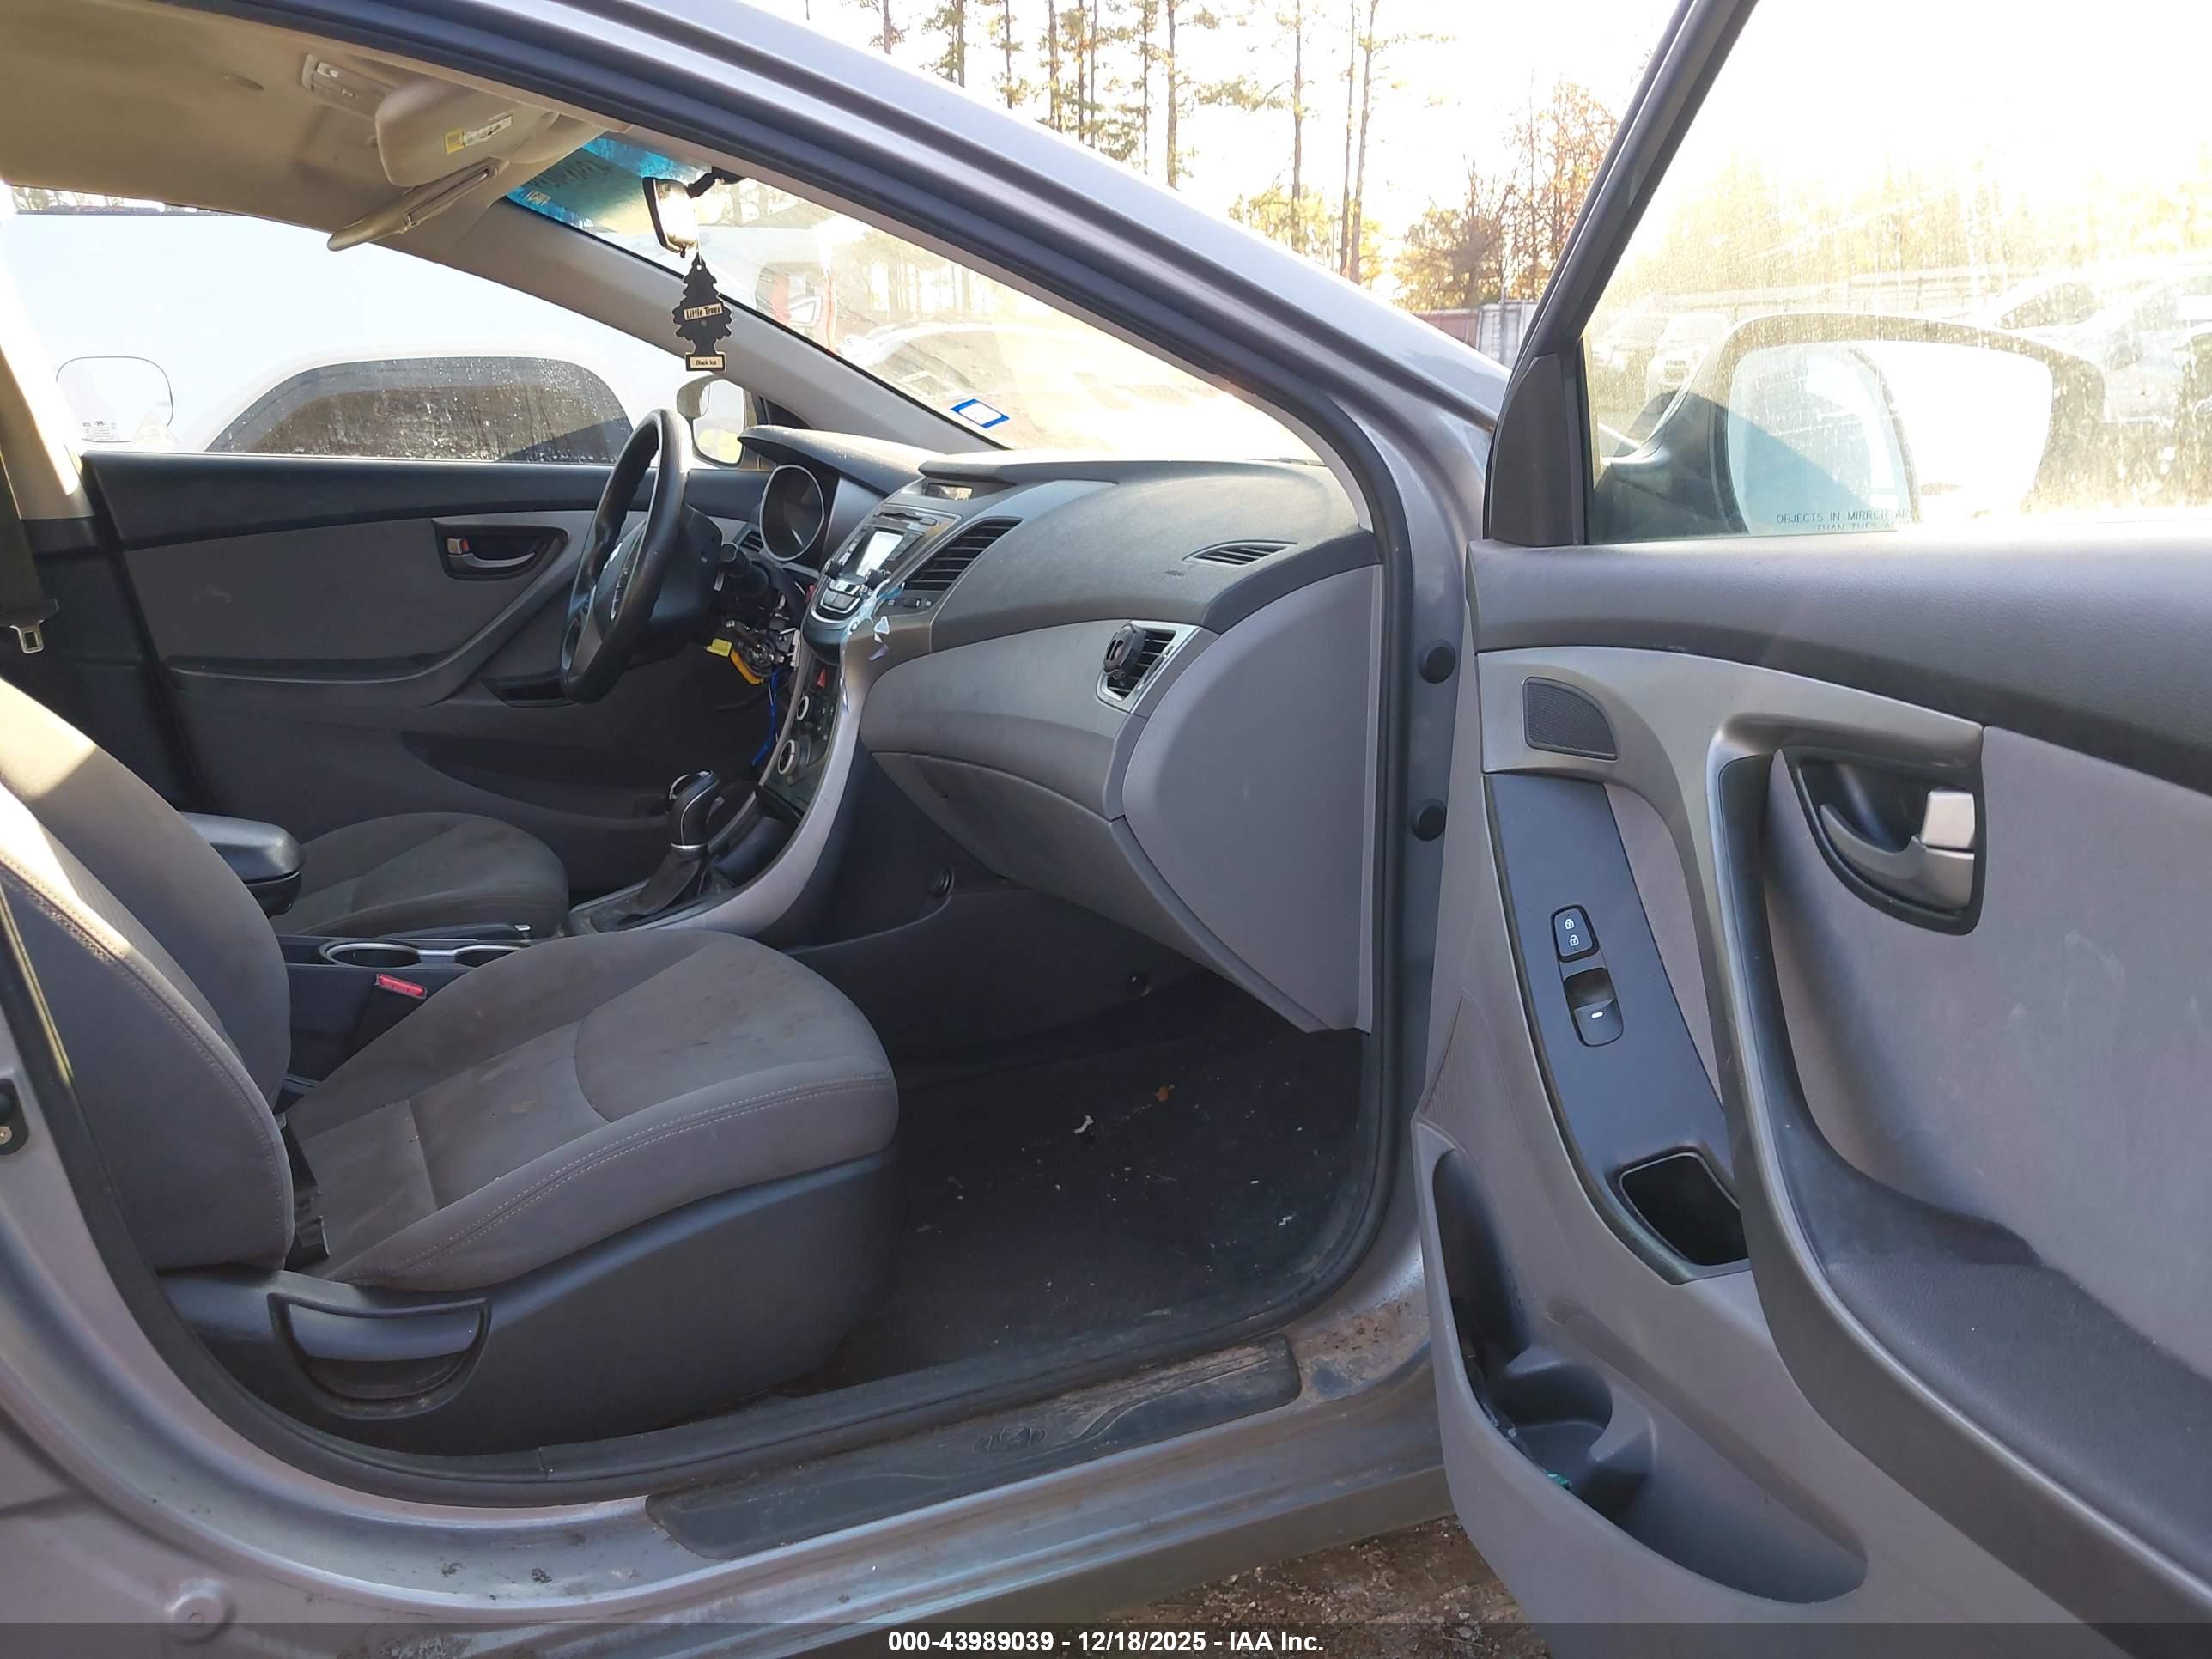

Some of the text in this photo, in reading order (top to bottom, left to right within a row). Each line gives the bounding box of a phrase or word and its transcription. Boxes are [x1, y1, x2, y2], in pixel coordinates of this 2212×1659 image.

[685, 306, 720, 319] Little Trees
[1776, 512, 1824, 524] OBJECTS
[1830, 512, 1840, 522] IN
[1847, 508, 1888, 521] MIRROR
